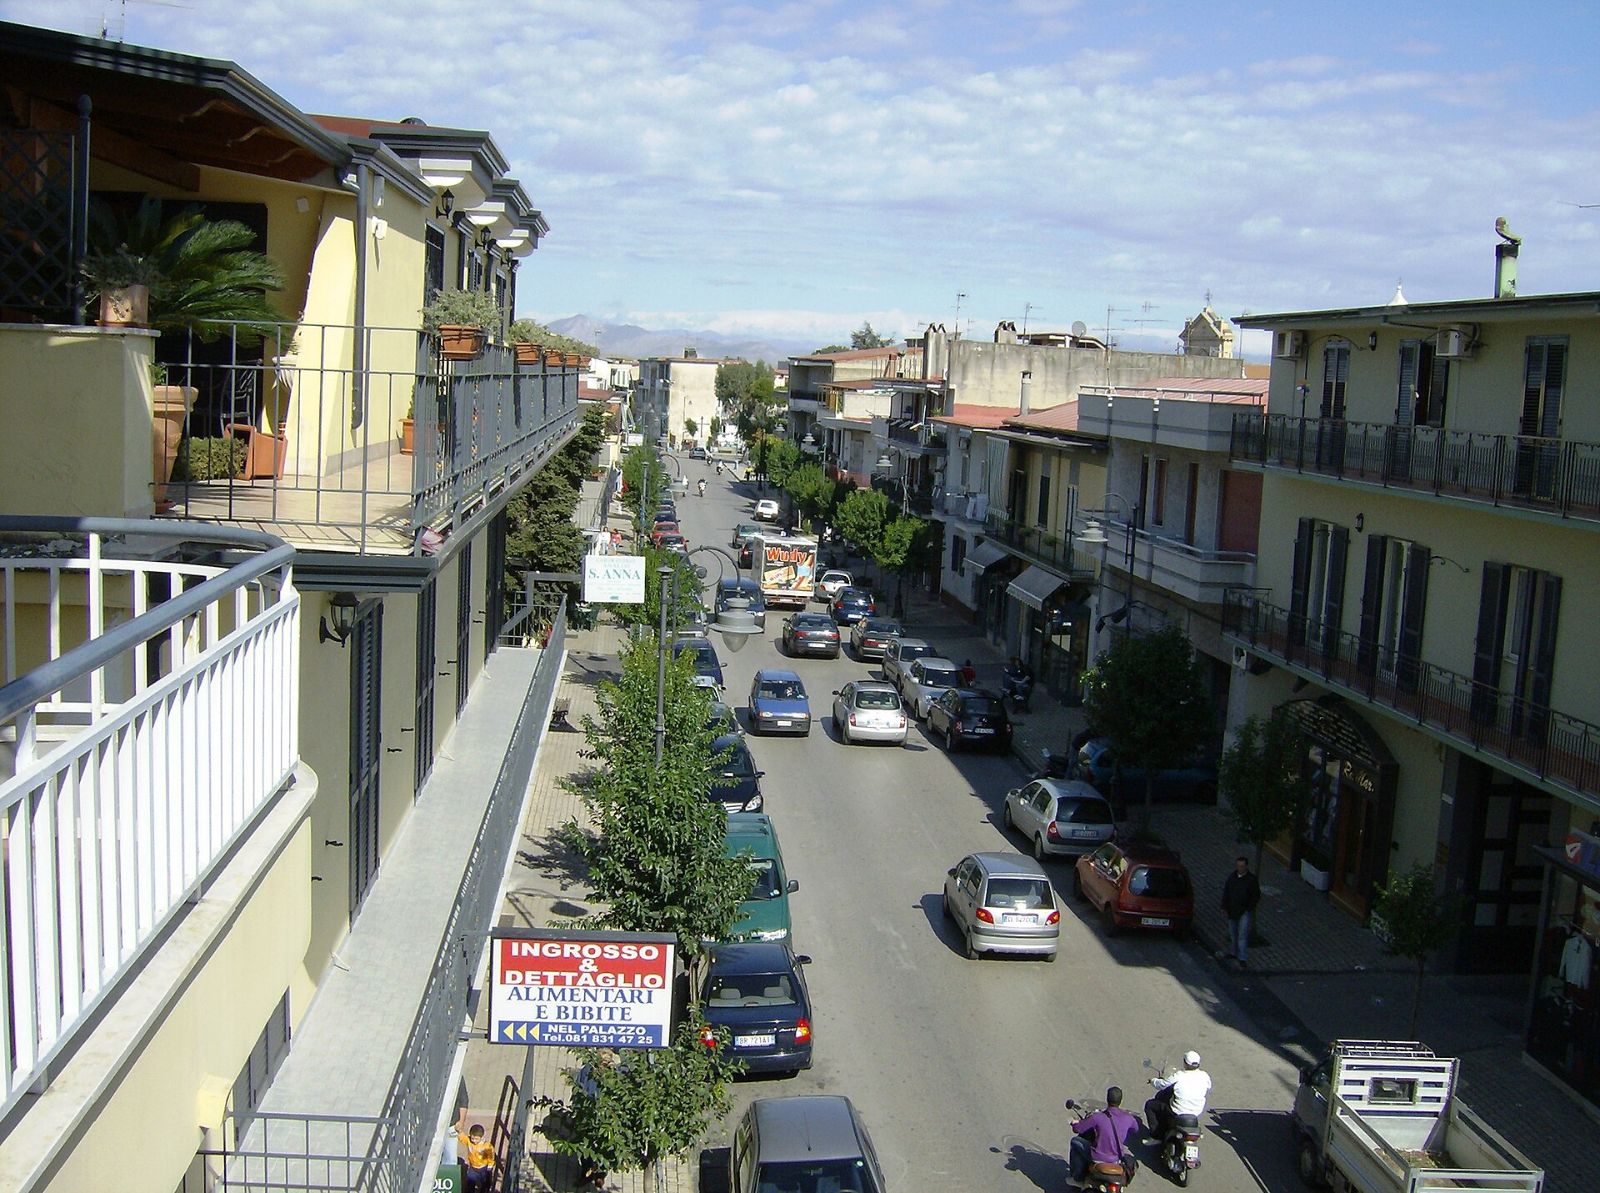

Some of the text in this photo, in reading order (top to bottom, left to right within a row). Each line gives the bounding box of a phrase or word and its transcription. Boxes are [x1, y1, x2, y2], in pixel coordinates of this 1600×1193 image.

[766, 547, 807, 566] Wudy
[589, 568, 641, 580] S. ANNA
[511, 942, 659, 961] INGROSSO
[579, 958, 599, 973] &
[504, 970, 663, 989] DETTAGLIO
[508, 986, 654, 1004] ALIMENTARI
[535, 1004, 632, 1022] E BIBITE
[548, 1024, 646, 1036] NEL PALAZZO
[592, 1034, 614, 1044] 831
[619, 1035, 634, 1044] 47
[637, 1035, 653, 1045] 25
